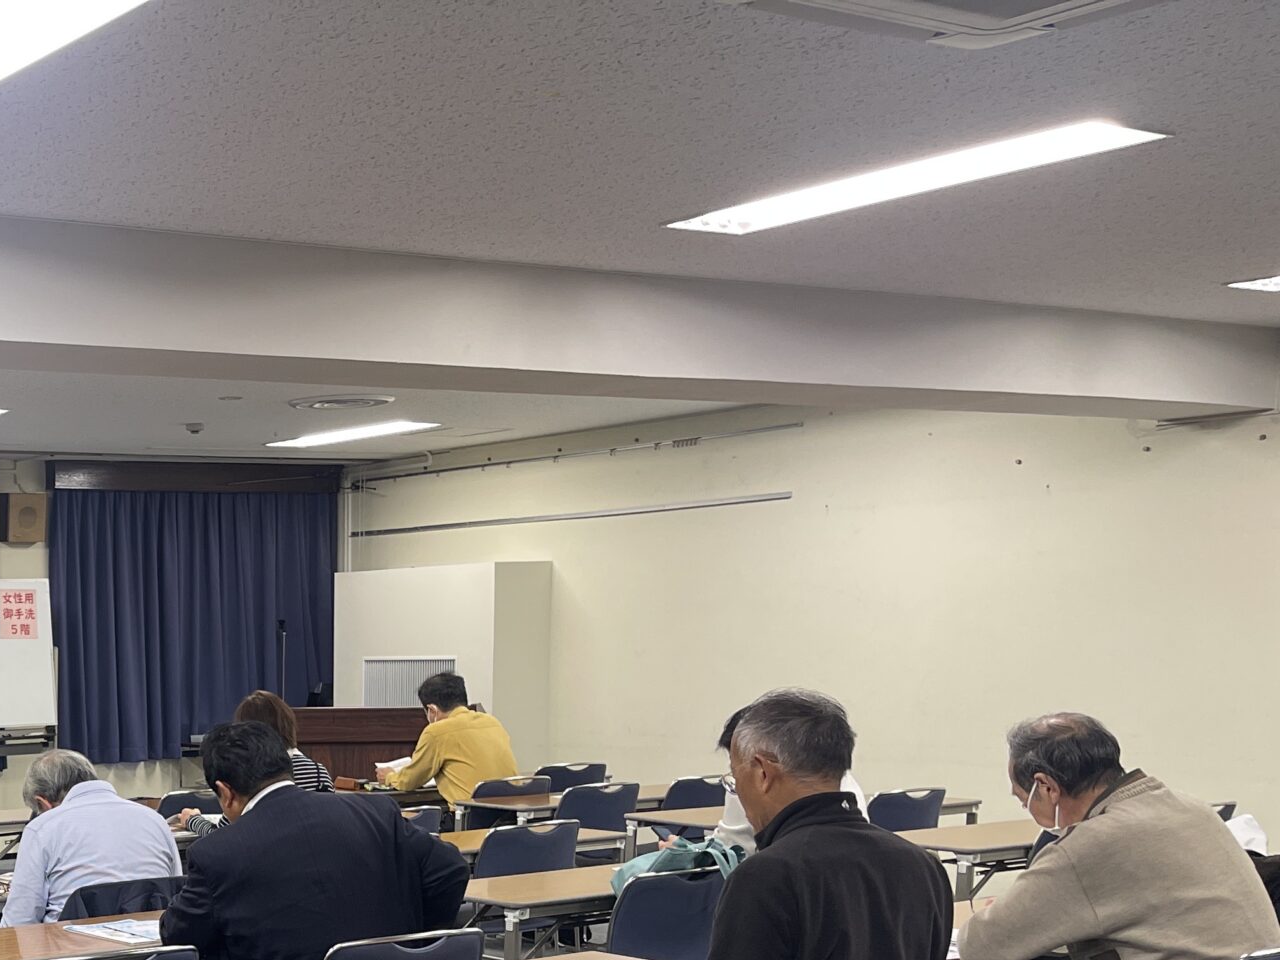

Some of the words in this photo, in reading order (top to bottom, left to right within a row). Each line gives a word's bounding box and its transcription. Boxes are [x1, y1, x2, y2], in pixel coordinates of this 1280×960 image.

[2, 592, 35, 605] 女性用
[2, 607, 36, 621] 御手洗
[10, 623, 31, 636] 5階
